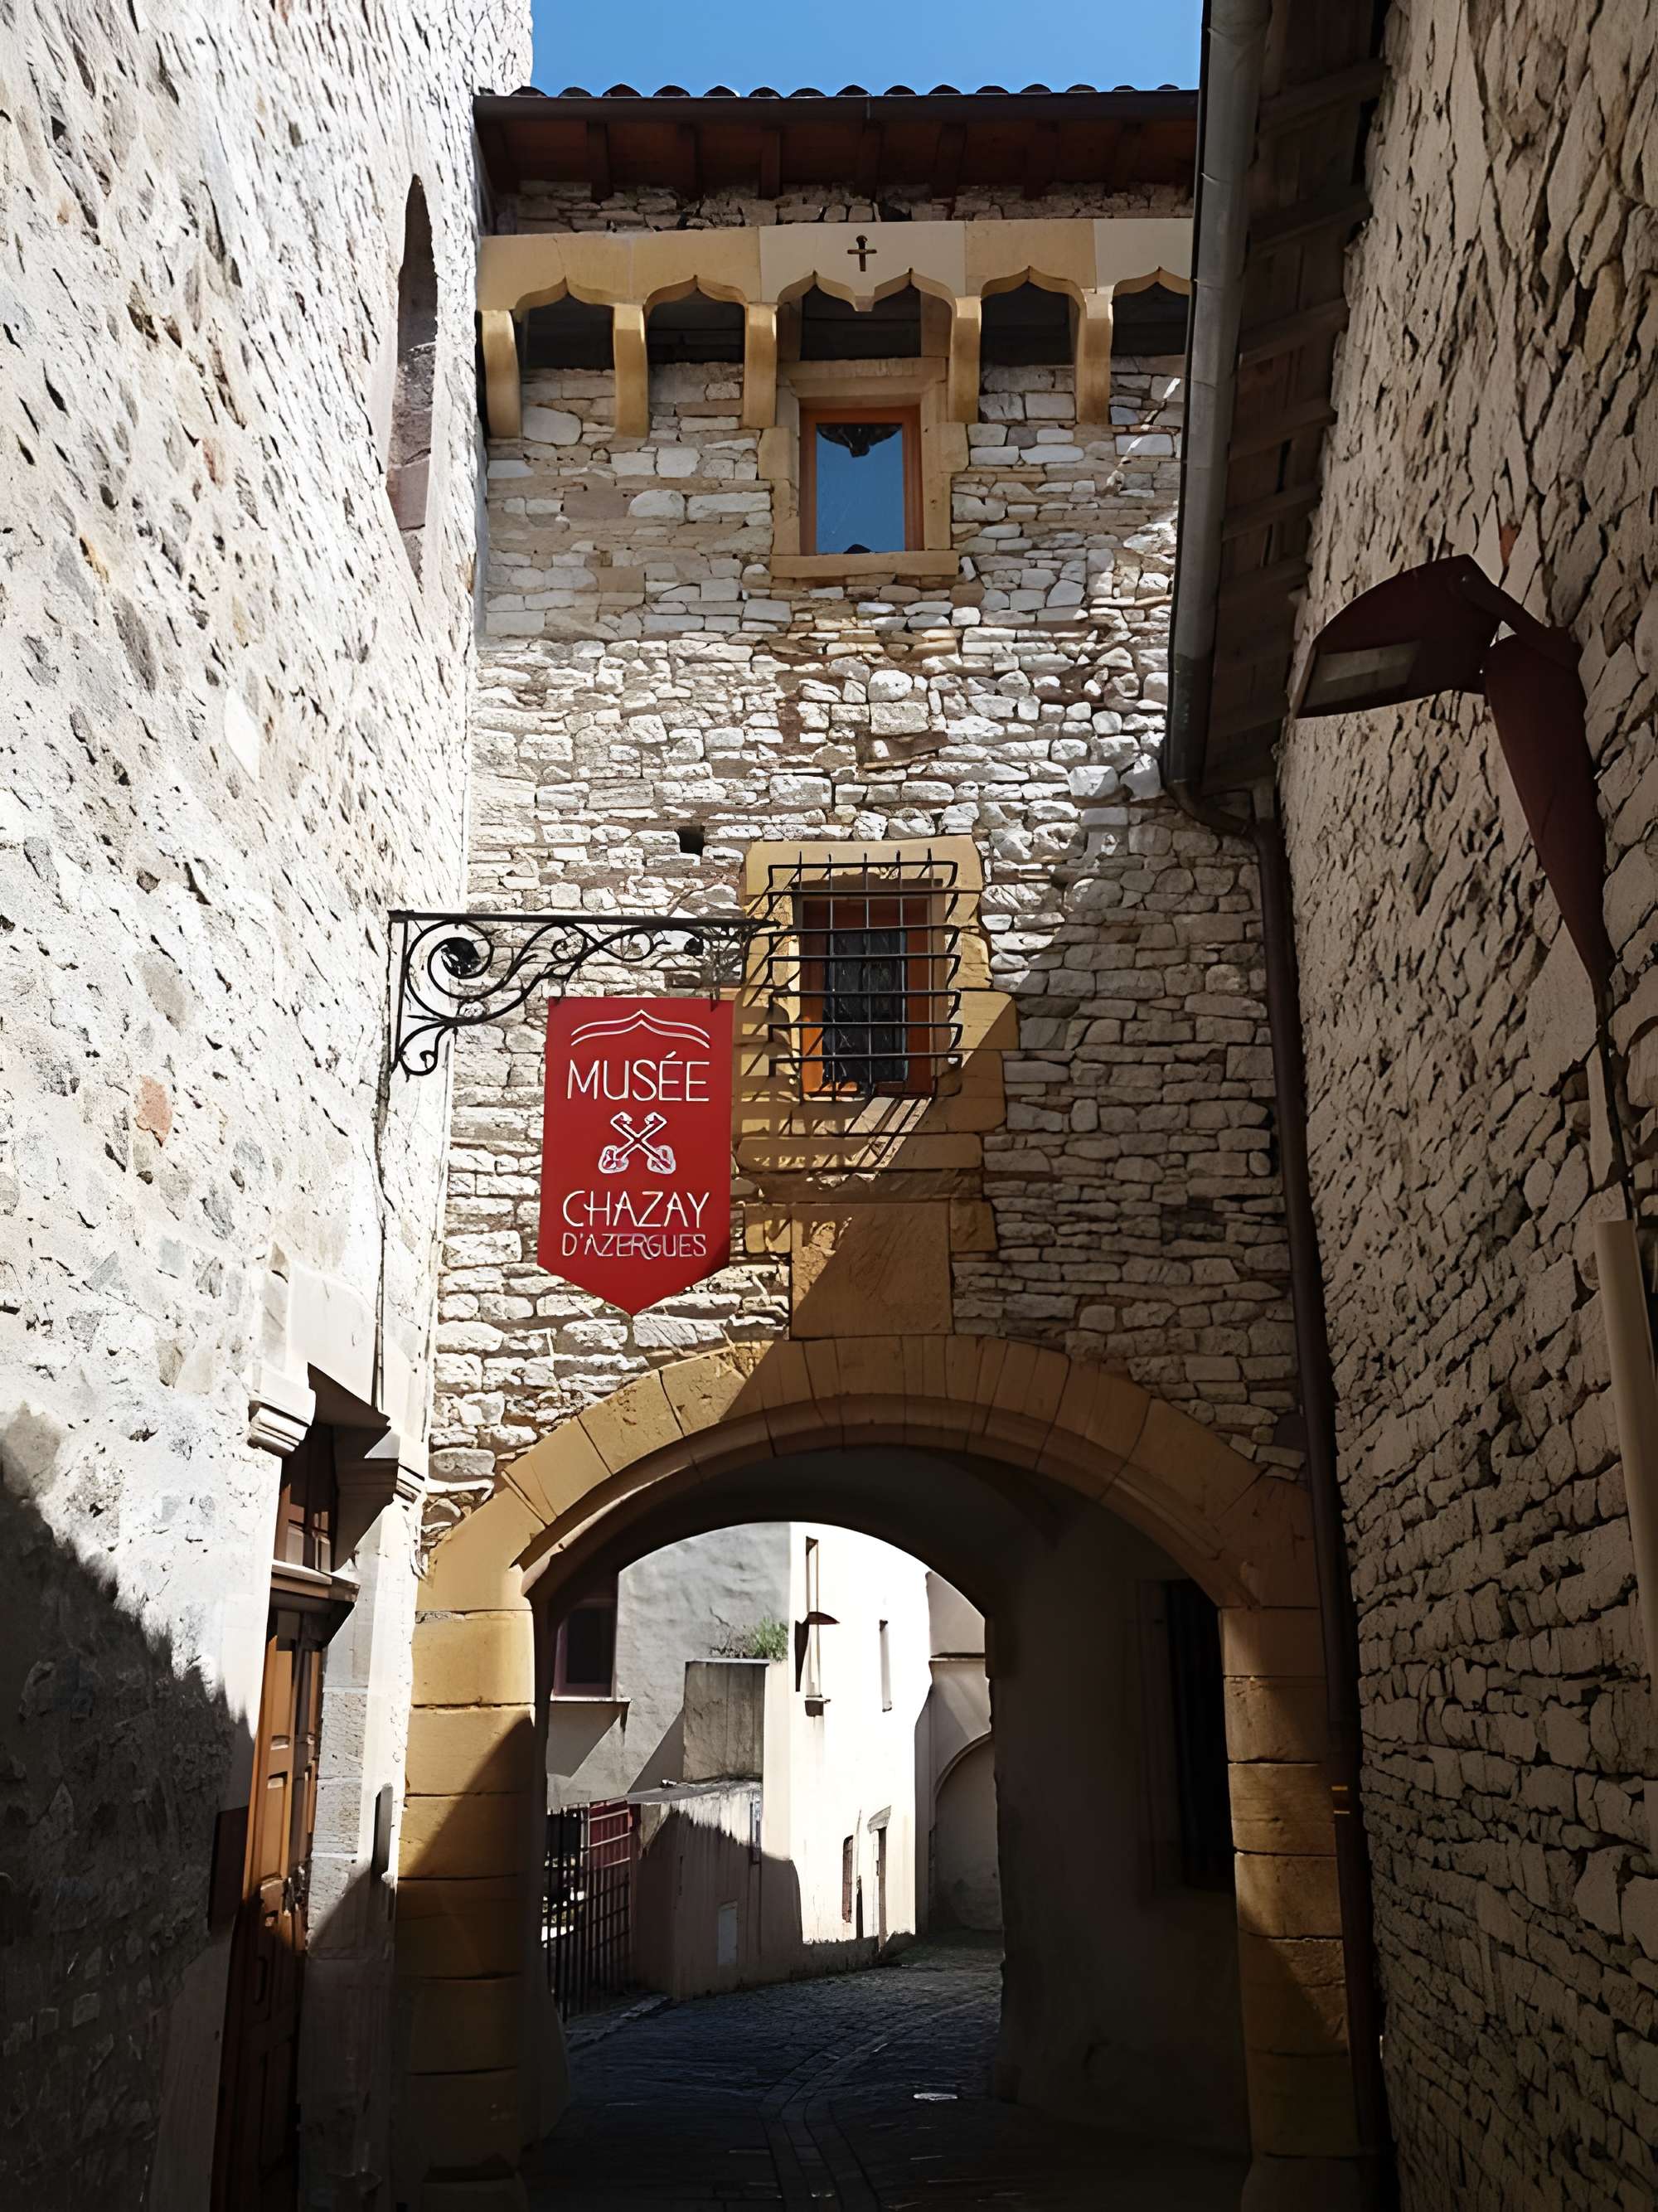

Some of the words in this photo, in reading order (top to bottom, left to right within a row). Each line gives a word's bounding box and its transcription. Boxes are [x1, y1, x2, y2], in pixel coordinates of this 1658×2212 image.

[567, 1050, 710, 1102] MUSÉE
[562, 1191, 710, 1228] CHAZAY
[562, 1232, 707, 1260] D'AZERGUES
